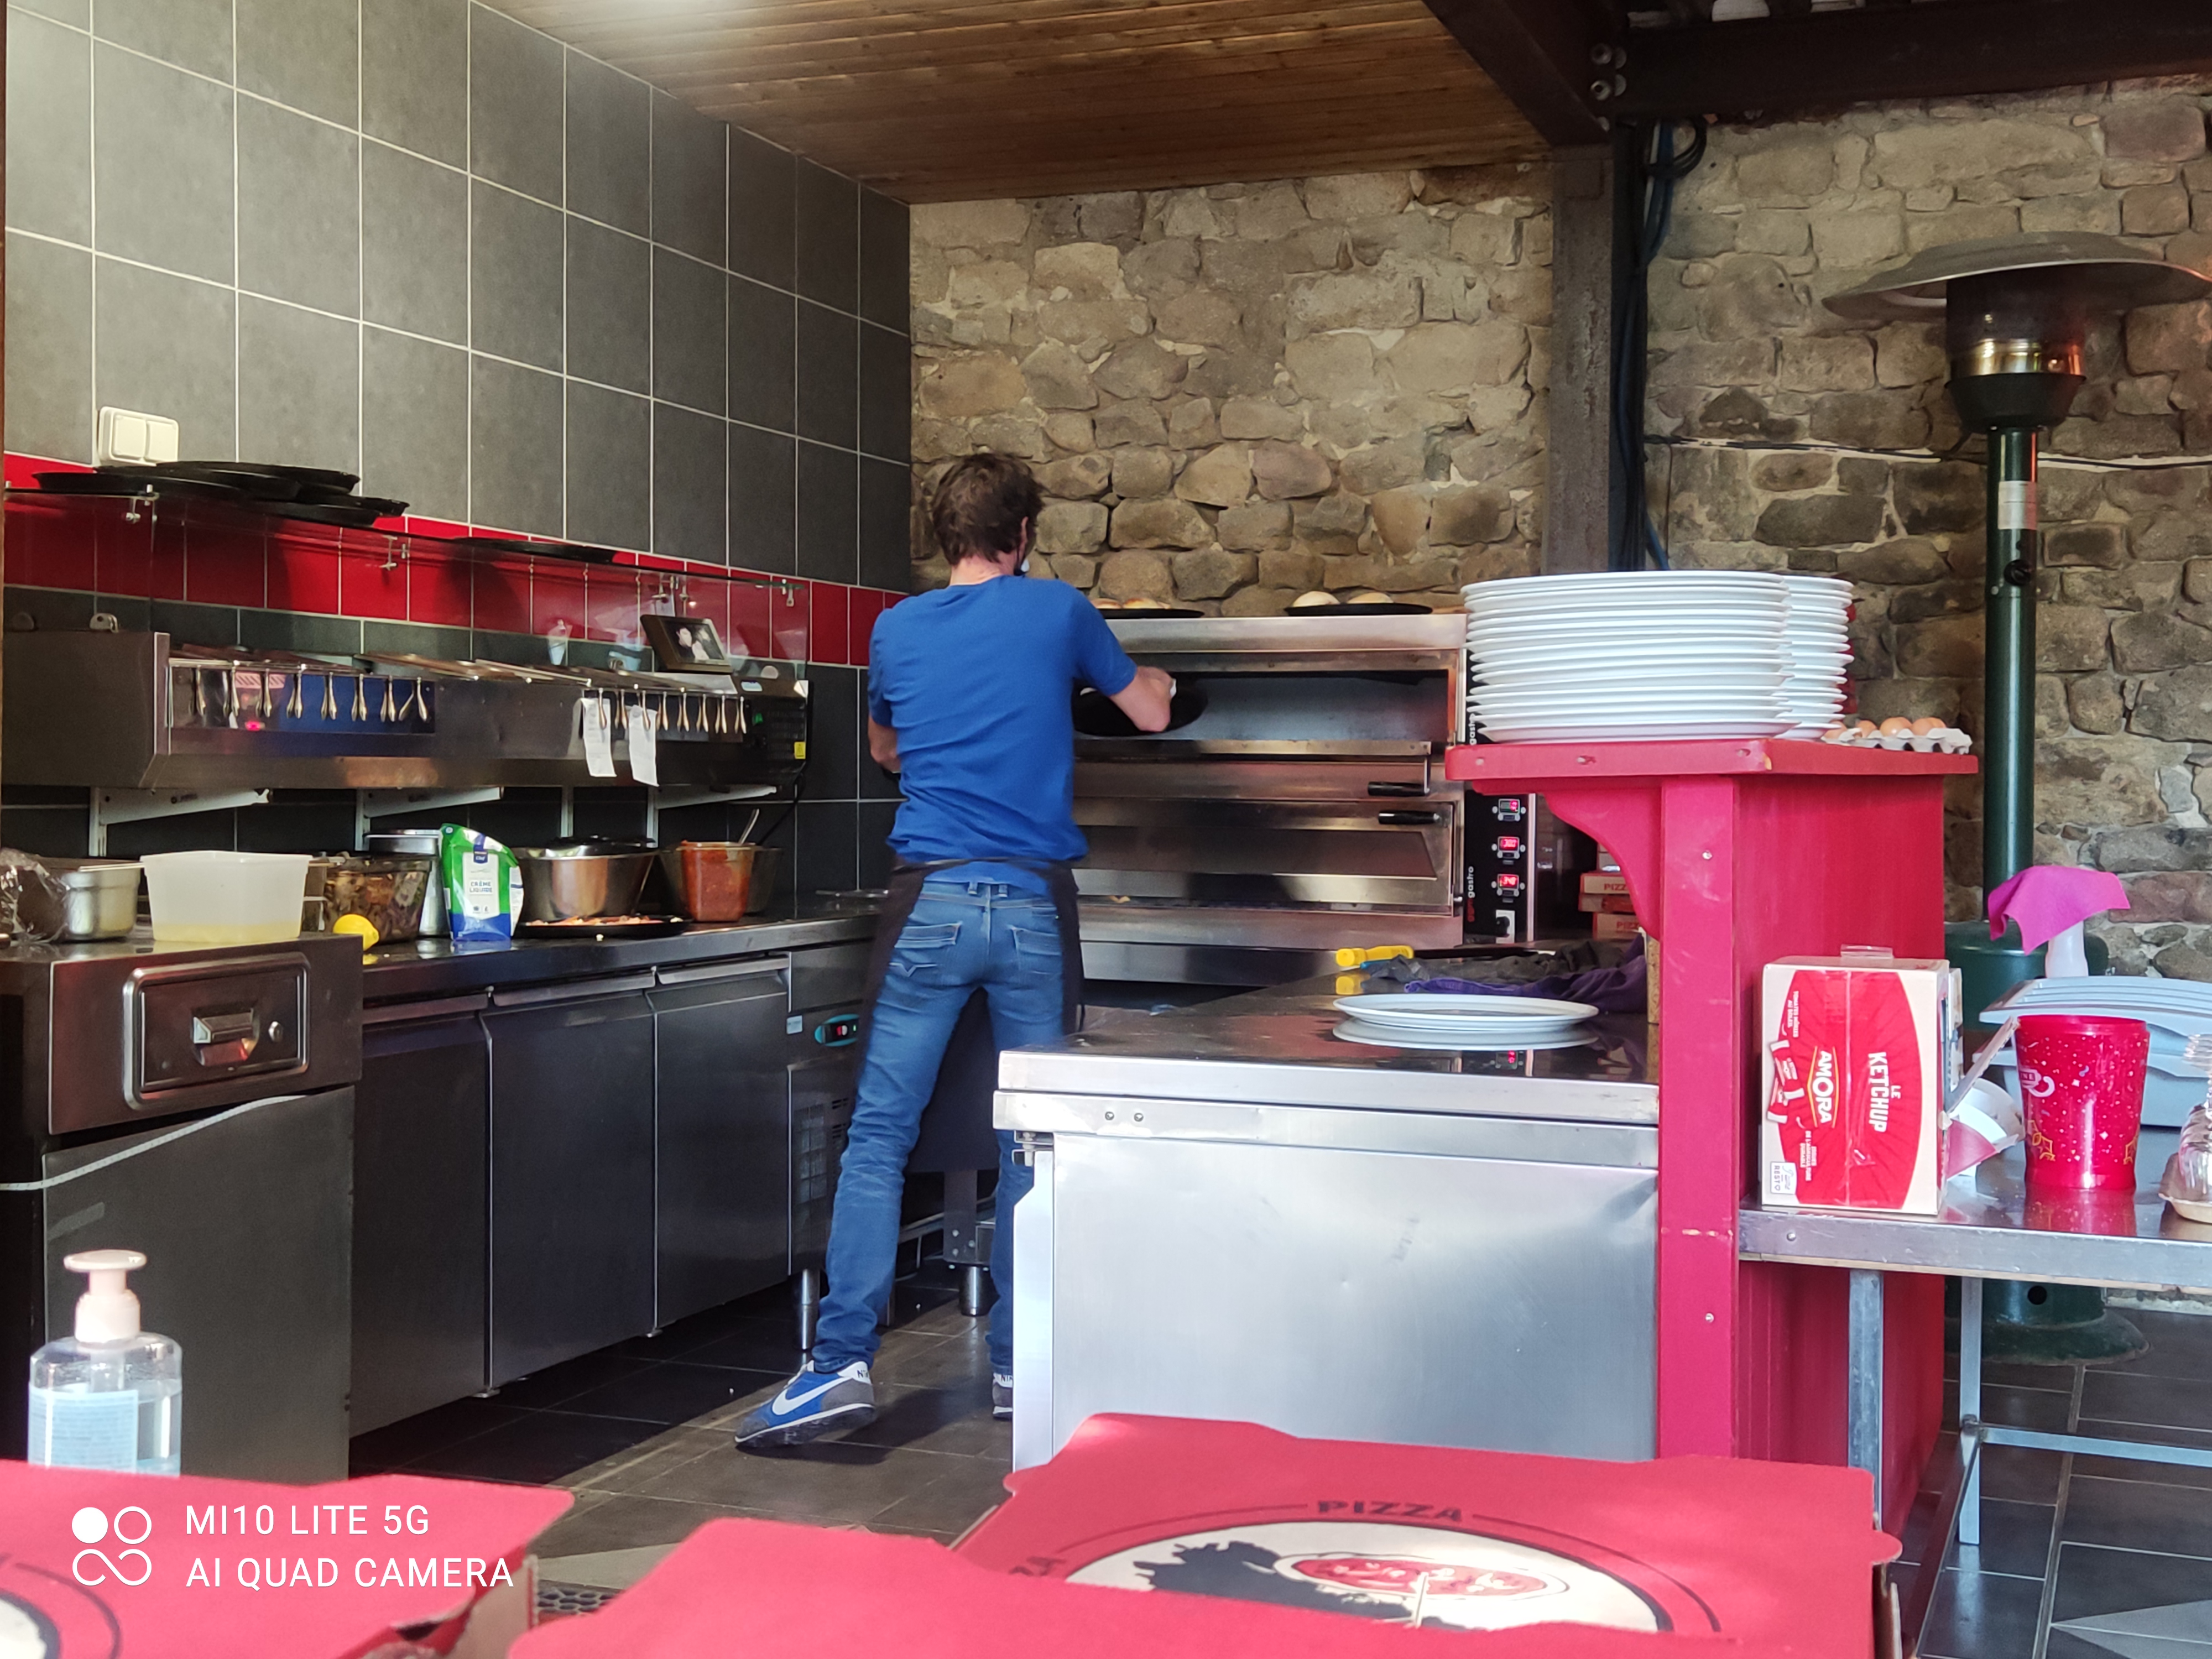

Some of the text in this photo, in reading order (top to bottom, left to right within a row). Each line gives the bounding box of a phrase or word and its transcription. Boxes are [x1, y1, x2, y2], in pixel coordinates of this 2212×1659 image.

[1813, 1051, 1834, 1123] AMORA
[1868, 1052, 1889, 1132] KETCHUP
[1891, 1085, 1901, 1099] LE
[1318, 1500, 1462, 1521] PIZZA
